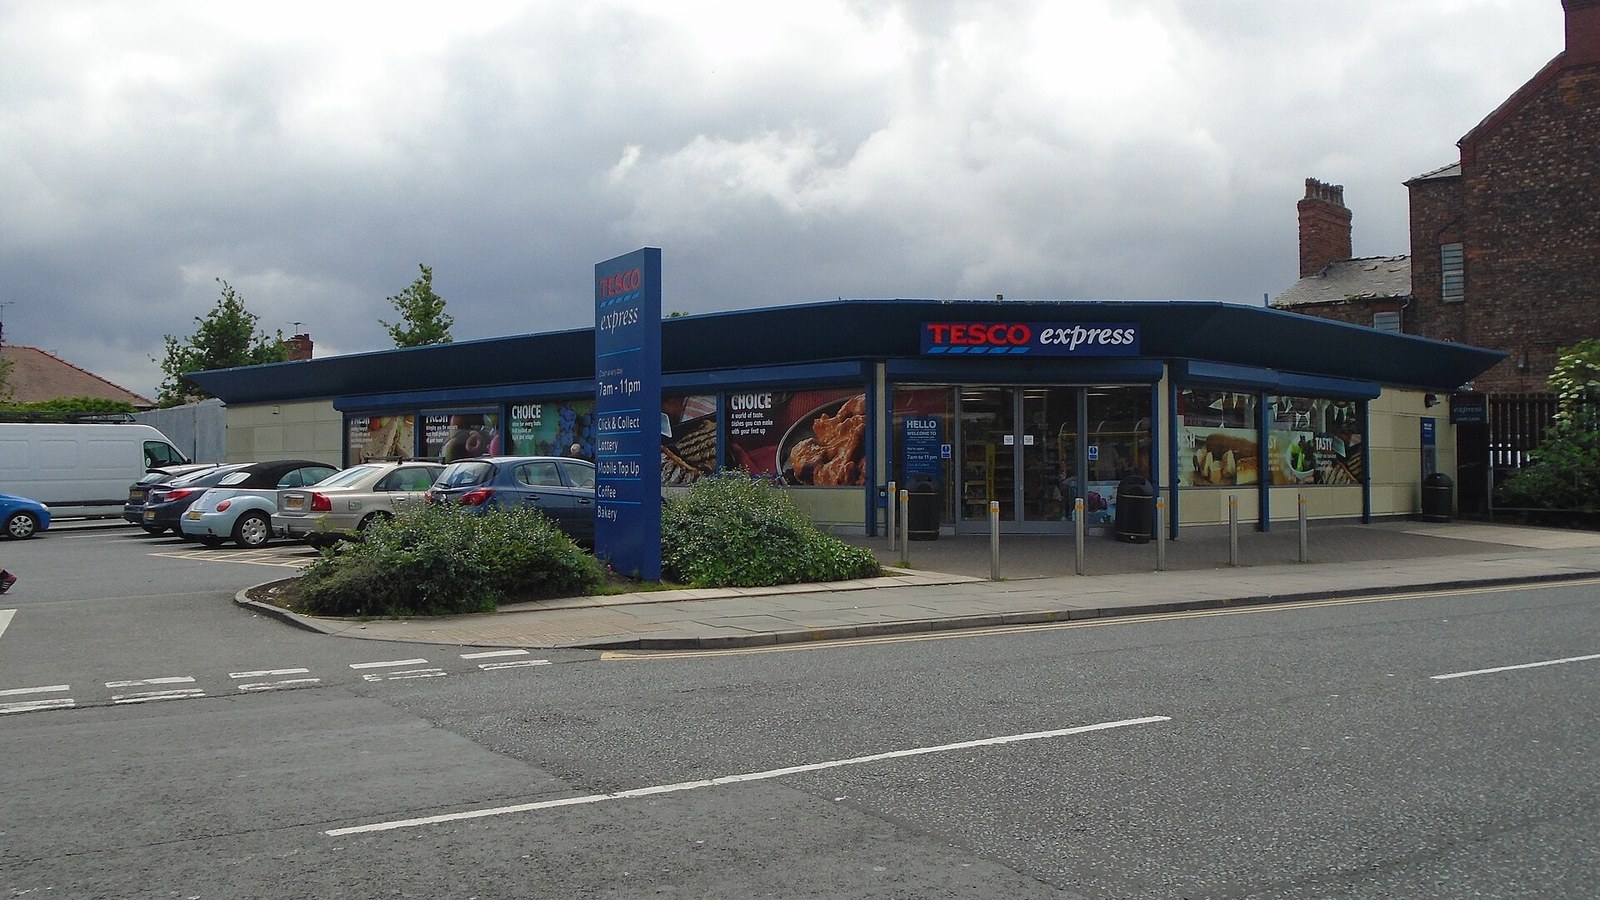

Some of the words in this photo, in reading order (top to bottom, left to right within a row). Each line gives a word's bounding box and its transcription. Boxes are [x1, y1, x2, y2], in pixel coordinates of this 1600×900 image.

[599, 269, 640, 297] TESCO
[600, 307, 639, 334] express
[927, 324, 1031, 345] TESCO
[1039, 325, 1135, 350] express
[599, 382, 613, 396] 7am
[620, 378, 641, 396] 11pm
[731, 393, 772, 410] CHOICE
[511, 404, 542, 420] CHOICE
[598, 418, 611, 430] Click
[618, 415, 640, 429] Collect
[906, 420, 937, 429] HELLO
[760, 428, 766, 436] up
[598, 440, 618, 453] Lottery
[1315, 437, 1333, 451] TASTY
[598, 461, 617, 474] Mobile
[618, 461, 630, 477] Top
[630, 461, 640, 477] Up
[598, 485, 617, 498] Coffee
[598, 505, 617, 522] Bakery
